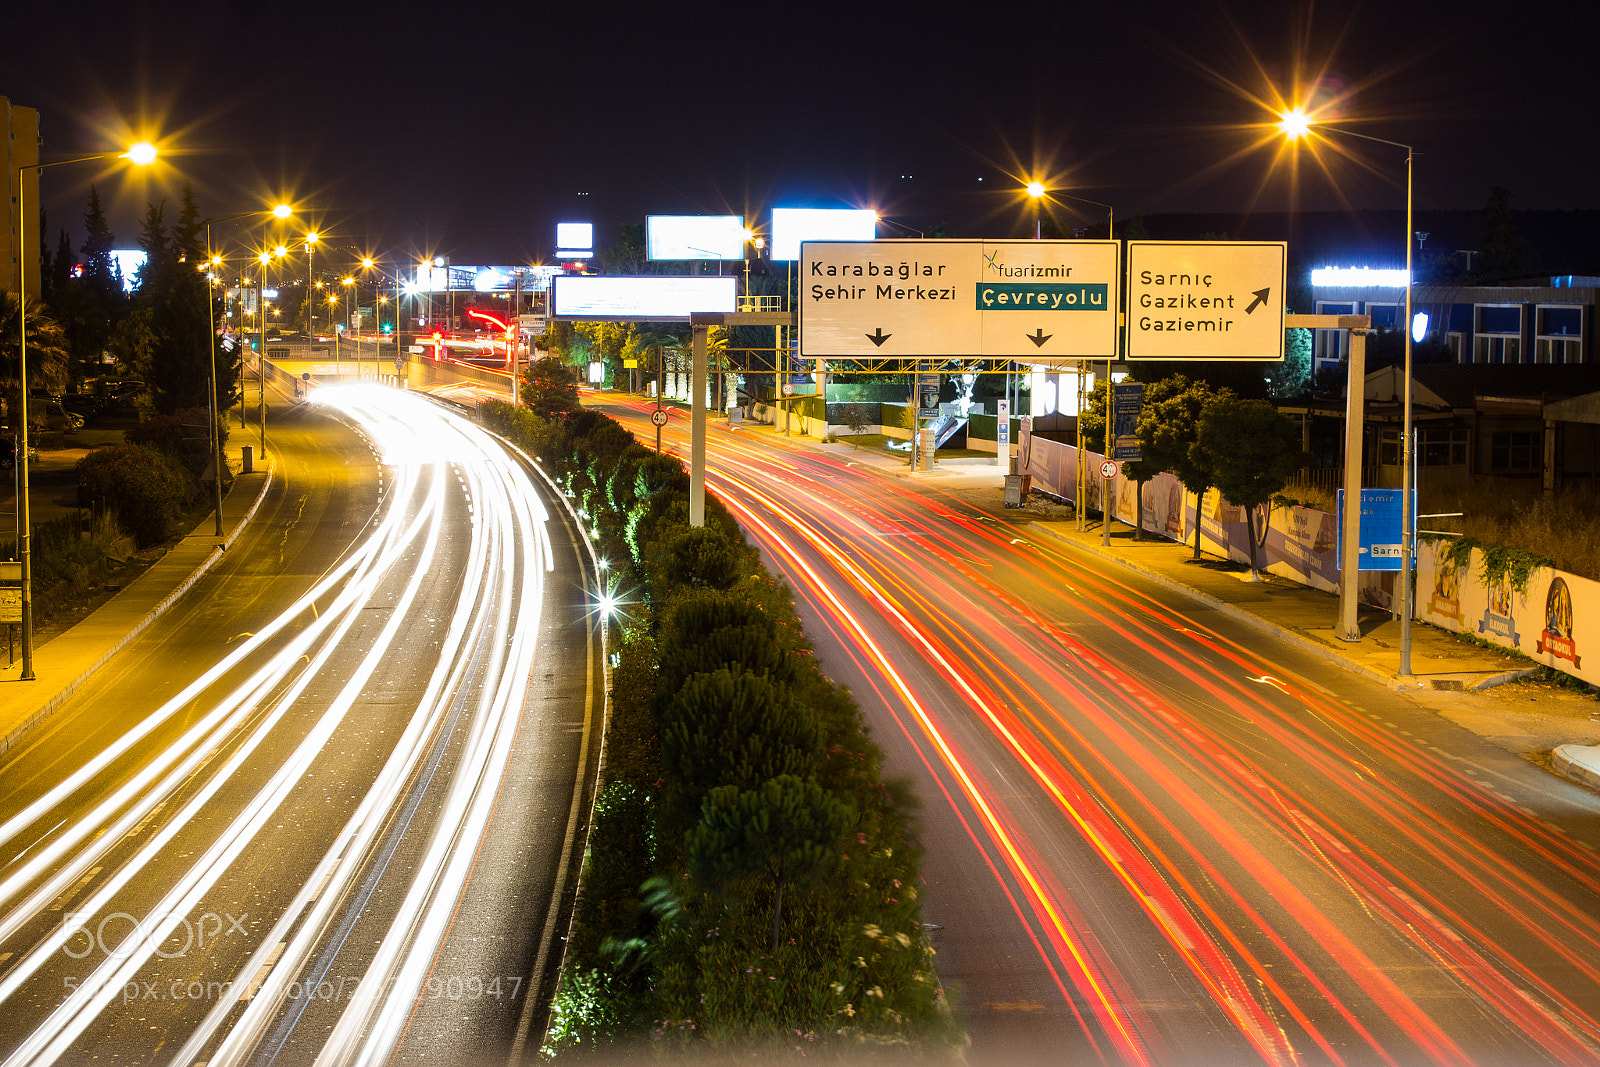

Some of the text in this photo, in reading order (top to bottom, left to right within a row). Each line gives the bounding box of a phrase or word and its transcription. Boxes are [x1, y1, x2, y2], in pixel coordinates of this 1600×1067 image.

[811, 261, 946, 280] Karabağlar
[998, 263, 1073, 278] fuarizmir
[1140, 270, 1213, 288] Sarnıç
[811, 284, 956, 301] Şehir Merkezi
[982, 288, 1102, 309] Çevreyolu
[1140, 293, 1235, 309] Gazikent
[1139, 316, 1234, 332] Gaziemir
[1373, 546, 1400, 555] Sarn
[1545, 636, 1572, 657] ORTAOKUL
